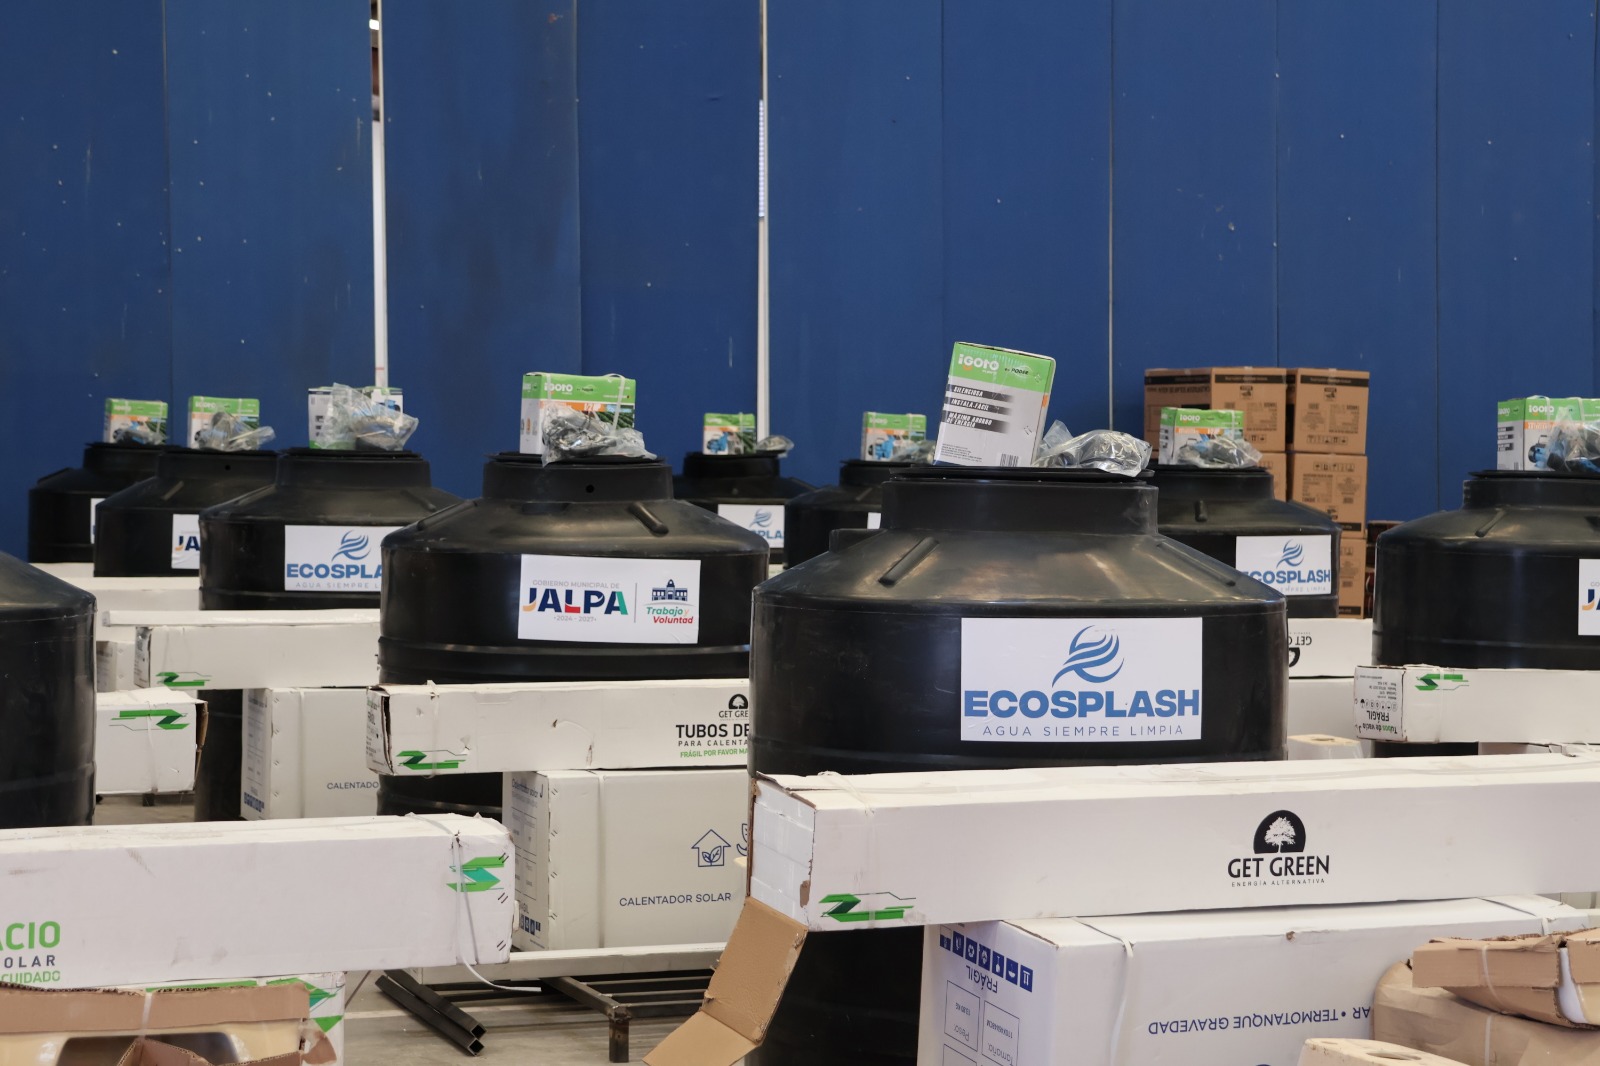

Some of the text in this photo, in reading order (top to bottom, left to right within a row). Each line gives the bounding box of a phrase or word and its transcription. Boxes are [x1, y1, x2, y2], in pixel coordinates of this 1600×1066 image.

[532, 579, 569, 587] GOBIERNO
[1243, 569, 1331, 584] COSPLASH
[522, 588, 628, 615] JALPA
[646, 606, 683, 617] Trabajo
[653, 616, 694, 624] Voluntad
[964, 689, 1200, 719] ECOSPLASH
[718, 710, 733, 718] GET
[675, 724, 728, 738] TUBOS
[982, 725, 1183, 736] AGUA SIEMPRE LIMPIA
[706, 739, 748, 747] CALENTA
[326, 781, 379, 790] CALENTADO
[1227, 855, 1330, 878] GET GREEN
[1271, 878, 1325, 886] ALTERNATIVA
[619, 892, 732, 907] CALENTADOR SOLAR
[0, 920, 61, 951] CIO
[1, 970, 61, 985] CUIDADO
[965, 965, 998, 994] FRÁGIL
[1148, 1006, 1371, 1035] AR TERMOTANQUE GRAVEDAD
